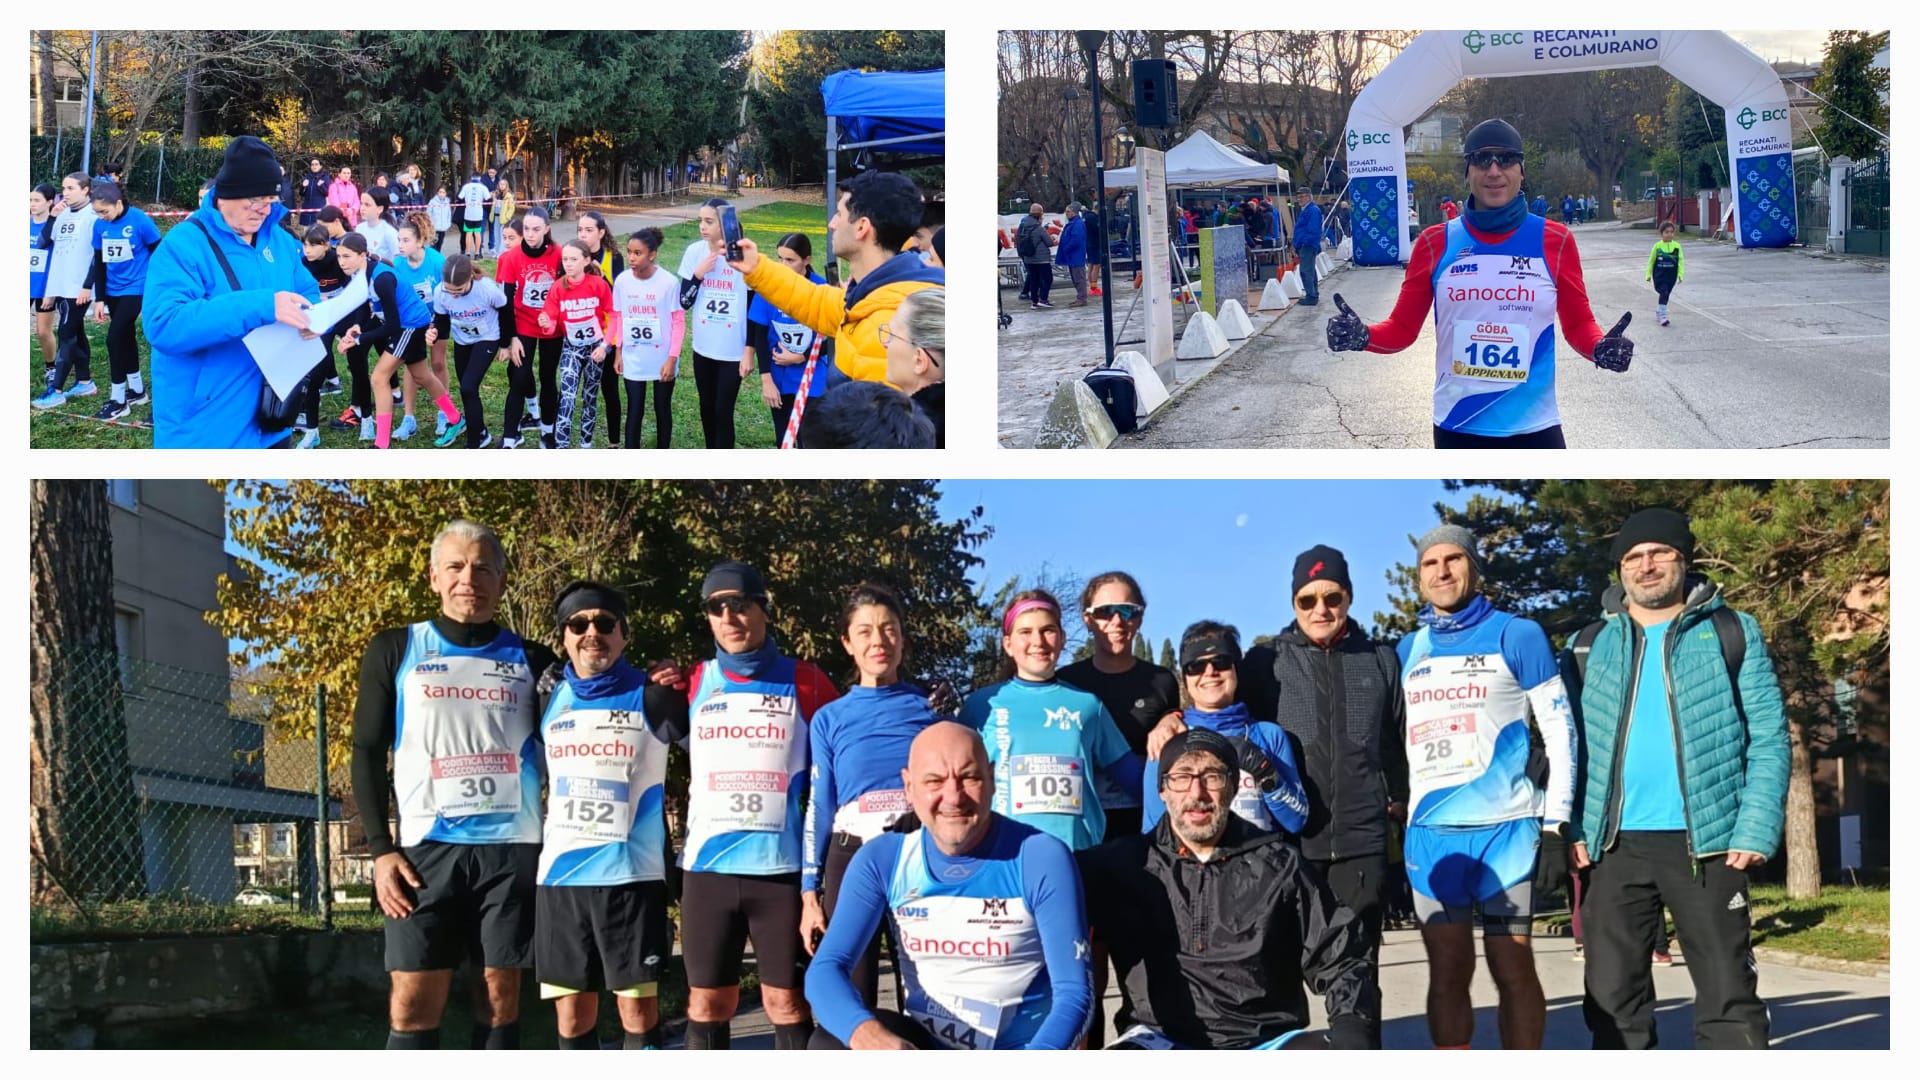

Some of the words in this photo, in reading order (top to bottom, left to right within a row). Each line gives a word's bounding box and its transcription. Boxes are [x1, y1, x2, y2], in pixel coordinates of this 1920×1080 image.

[1490, 32, 1524, 46] BCC
[1534, 47, 1544, 60] E
[1548, 37, 1658, 59] COLMURANO
[1762, 109, 1788, 122] BCC
[1362, 133, 1391, 144] BCC
[60, 223, 75, 234] 69
[107, 246, 123, 257] 57
[1450, 263, 1478, 274] AVIS
[530, 289, 549, 301] 26
[1447, 284, 1535, 302] Ranocchi
[706, 300, 730, 314] 42
[1498, 303, 1534, 312] software
[574, 327, 596, 340] 43
[631, 326, 653, 340] 36
[782, 332, 804, 346] 97
[1465, 342, 1520, 368] 164
[1463, 367, 1526, 379] APPIGNANO
[415, 663, 449, 672] AVIS
[421, 684, 518, 704] Ranocchi
[700, 701, 728, 713] AVIS
[550, 719, 576, 731] AVIS
[1424, 739, 1453, 762] 28
[460, 776, 497, 798] 30
[1025, 776, 1073, 797] 103
[729, 793, 763, 813] 38
[564, 799, 615, 824] 152
[896, 907, 929, 918] AVIS
